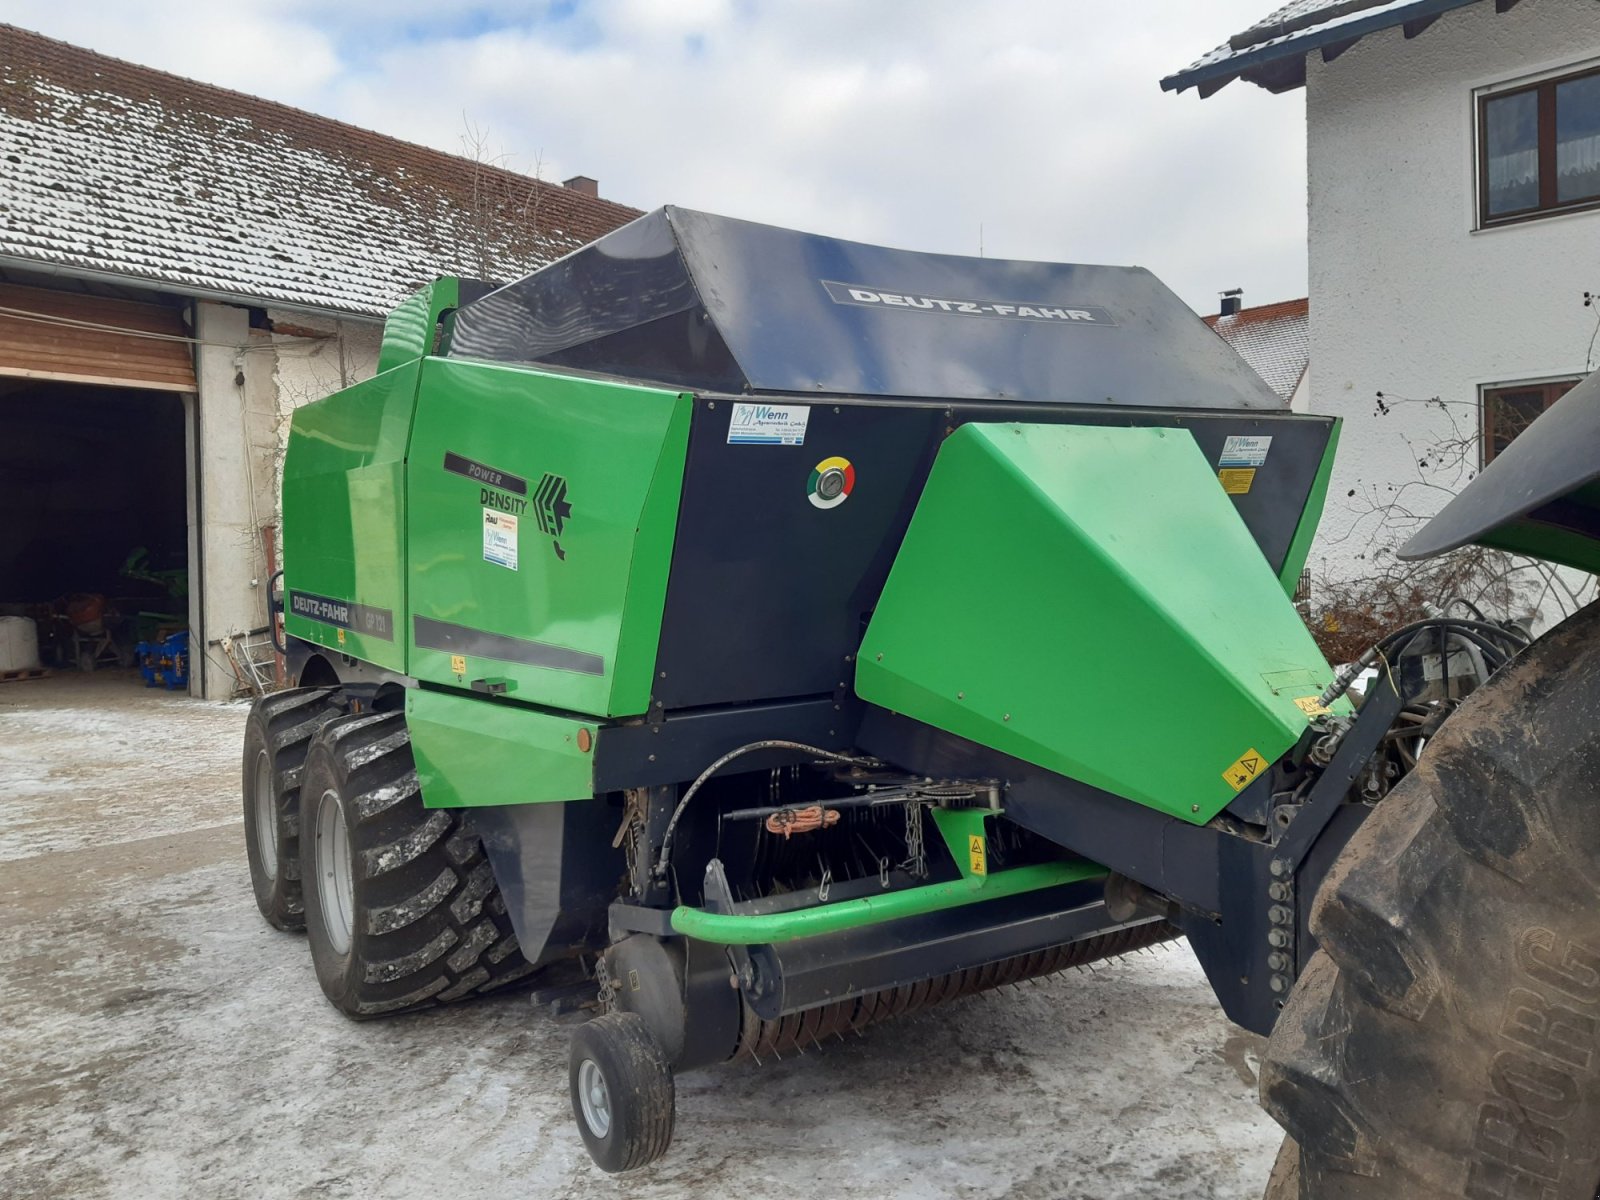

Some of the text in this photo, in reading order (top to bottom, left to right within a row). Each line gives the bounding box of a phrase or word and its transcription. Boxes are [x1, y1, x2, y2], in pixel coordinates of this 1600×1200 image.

[848, 289, 1096, 322] DEUTZ-FAHR
[755, 406, 789, 420] Wenn
[468, 463, 502, 485] POWER
[480, 488, 528, 515] DENSITY
[485, 513, 498, 525] RAU
[293, 595, 348, 623] DEUTZ-FAHR
